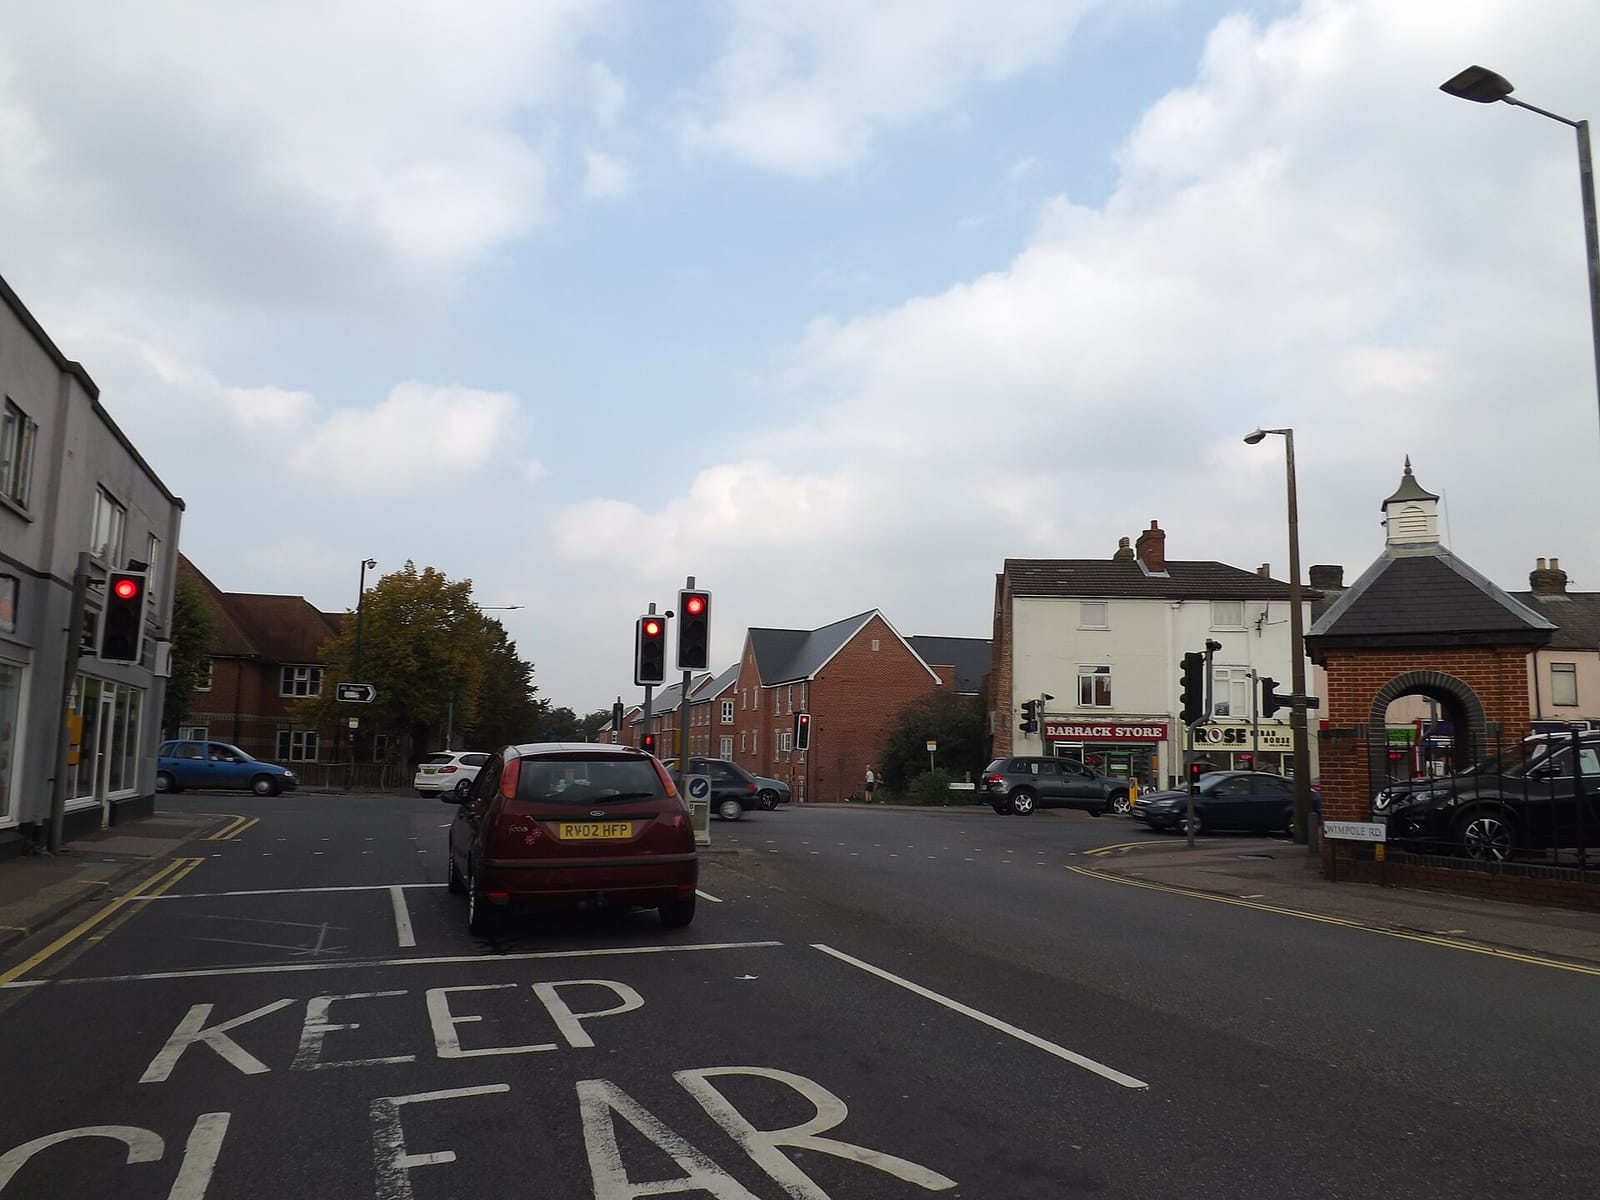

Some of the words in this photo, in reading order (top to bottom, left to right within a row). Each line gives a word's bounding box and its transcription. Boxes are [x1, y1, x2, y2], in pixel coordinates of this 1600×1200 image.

[1046, 726, 1112, 737] BARRACK
[1115, 727, 1163, 738] STORE
[1194, 727, 1247, 744] ROSE
[566, 824, 600, 838] RV02
[602, 824, 628, 837] HFP
[1326, 825, 1366, 836] WIMPOLE
[1368, 827, 1382, 837] RD
[138, 979, 645, 1084] KEEP
